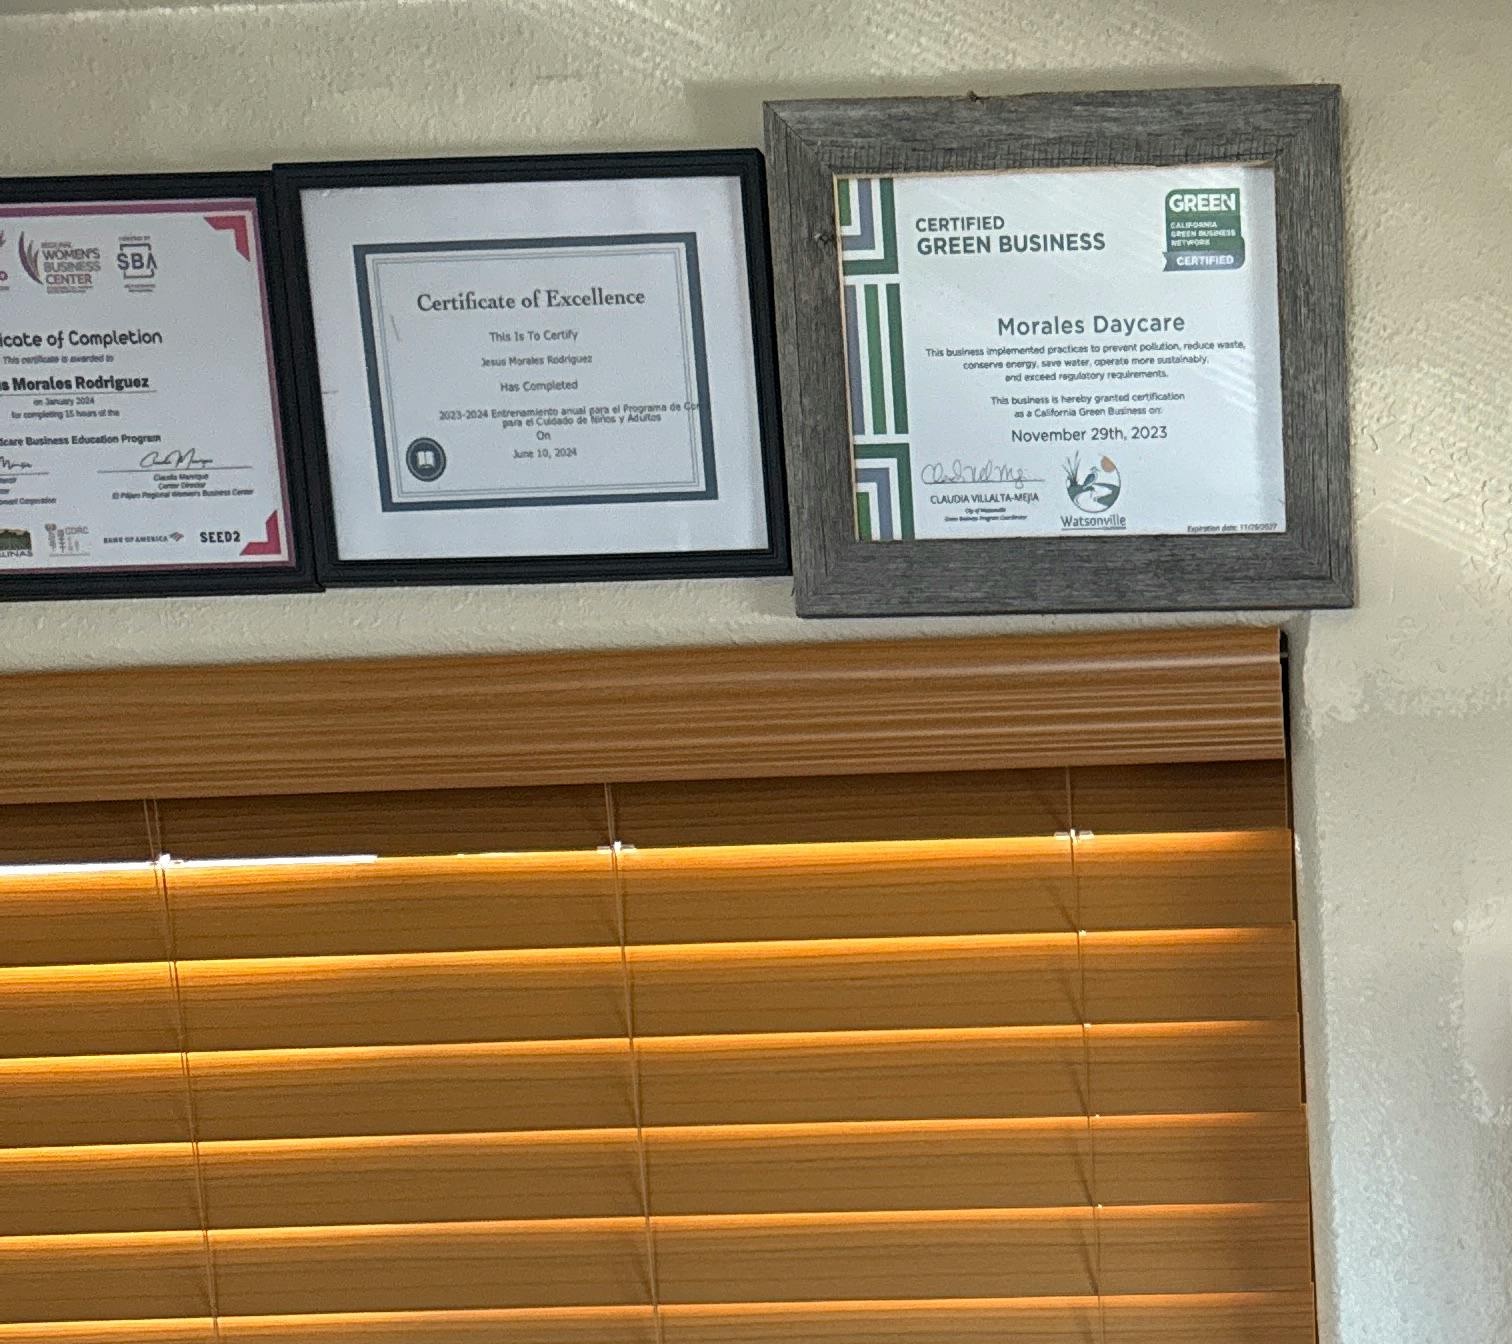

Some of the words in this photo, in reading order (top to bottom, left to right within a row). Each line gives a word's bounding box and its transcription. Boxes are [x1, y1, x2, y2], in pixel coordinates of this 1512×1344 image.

[1169, 193, 1236, 213] GREEN
[915, 216, 1005, 232] CERTIFIED
[917, 236, 991, 256] GREEN
[999, 232, 1105, 253] BUSINESS
[42, 248, 100, 260] WOMEN'S
[1176, 255, 1234, 266] CERTIFIED
[43, 261, 101, 272] BUSINESS
[117, 253, 158, 271] SBA
[46, 274, 92, 285] CENTER
[417, 291, 515, 311] Certificate
[521, 289, 541, 308] of
[546, 288, 645, 307] Excellence
[998, 315, 1085, 336] Morales
[1094, 315, 1185, 336] Daycare
[46, 330, 64, 349] of
[68, 329, 162, 348] Completion
[488, 332, 511, 342] This
[514, 331, 525, 342] Is
[527, 331, 541, 341] To
[543, 329, 578, 341] Certify
[12, 376, 72, 391] Morales
[75, 375, 149, 391] Rodriguez
[500, 383, 520, 392] Has
[522, 380, 578, 392] Completed
[25, 436, 70, 446] Business
[71, 434, 119, 444] Education
[121, 434, 161, 445] Program
[536, 430, 551, 440] On
[1012, 428, 1086, 442] November
[1131, 426, 1167, 439] 2023
[513, 449, 534, 459] June
[554, 447, 577, 458] 2024
[930, 494, 970, 504] CLAUDIA
[1060, 514, 1126, 528] Watsonville
[200, 530, 240, 543] SEED2
